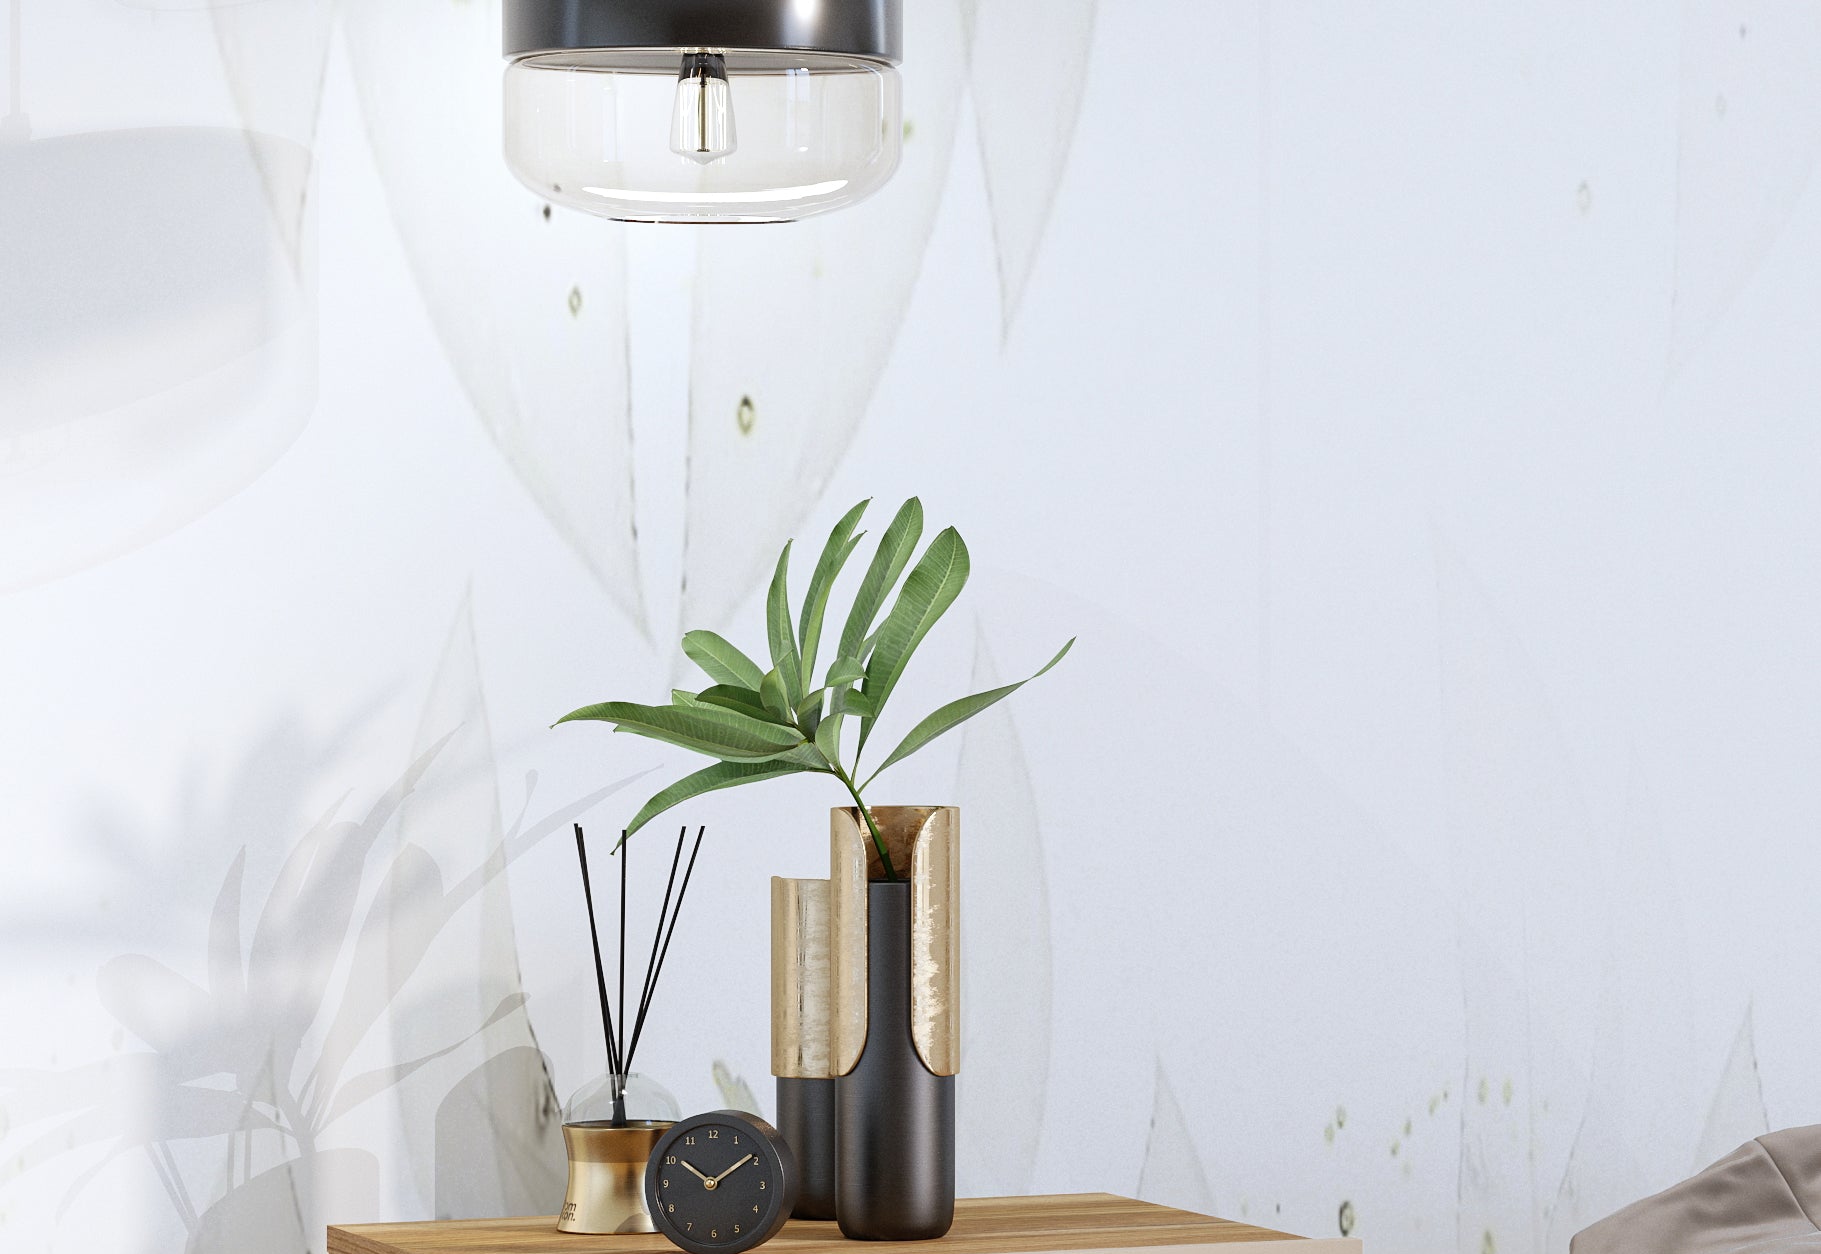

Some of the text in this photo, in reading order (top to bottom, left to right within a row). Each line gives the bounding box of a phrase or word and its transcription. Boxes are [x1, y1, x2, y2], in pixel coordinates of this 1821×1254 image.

[708, 1129, 719, 1139] 12
[685, 1136, 696, 1145] 11
[733, 1135, 739, 1145] 1
[665, 1156, 677, 1165] 10
[753, 1156, 759, 1166] 2
[663, 1179, 669, 1188] 9
[759, 1181, 766, 1190] 3
[668, 1204, 675, 1213] 8
[752, 1204, 759, 1214] 4
[686, 1222, 693, 1231] 7
[734, 1224, 740, 1233] 5
[711, 1229, 717, 1238] 6
